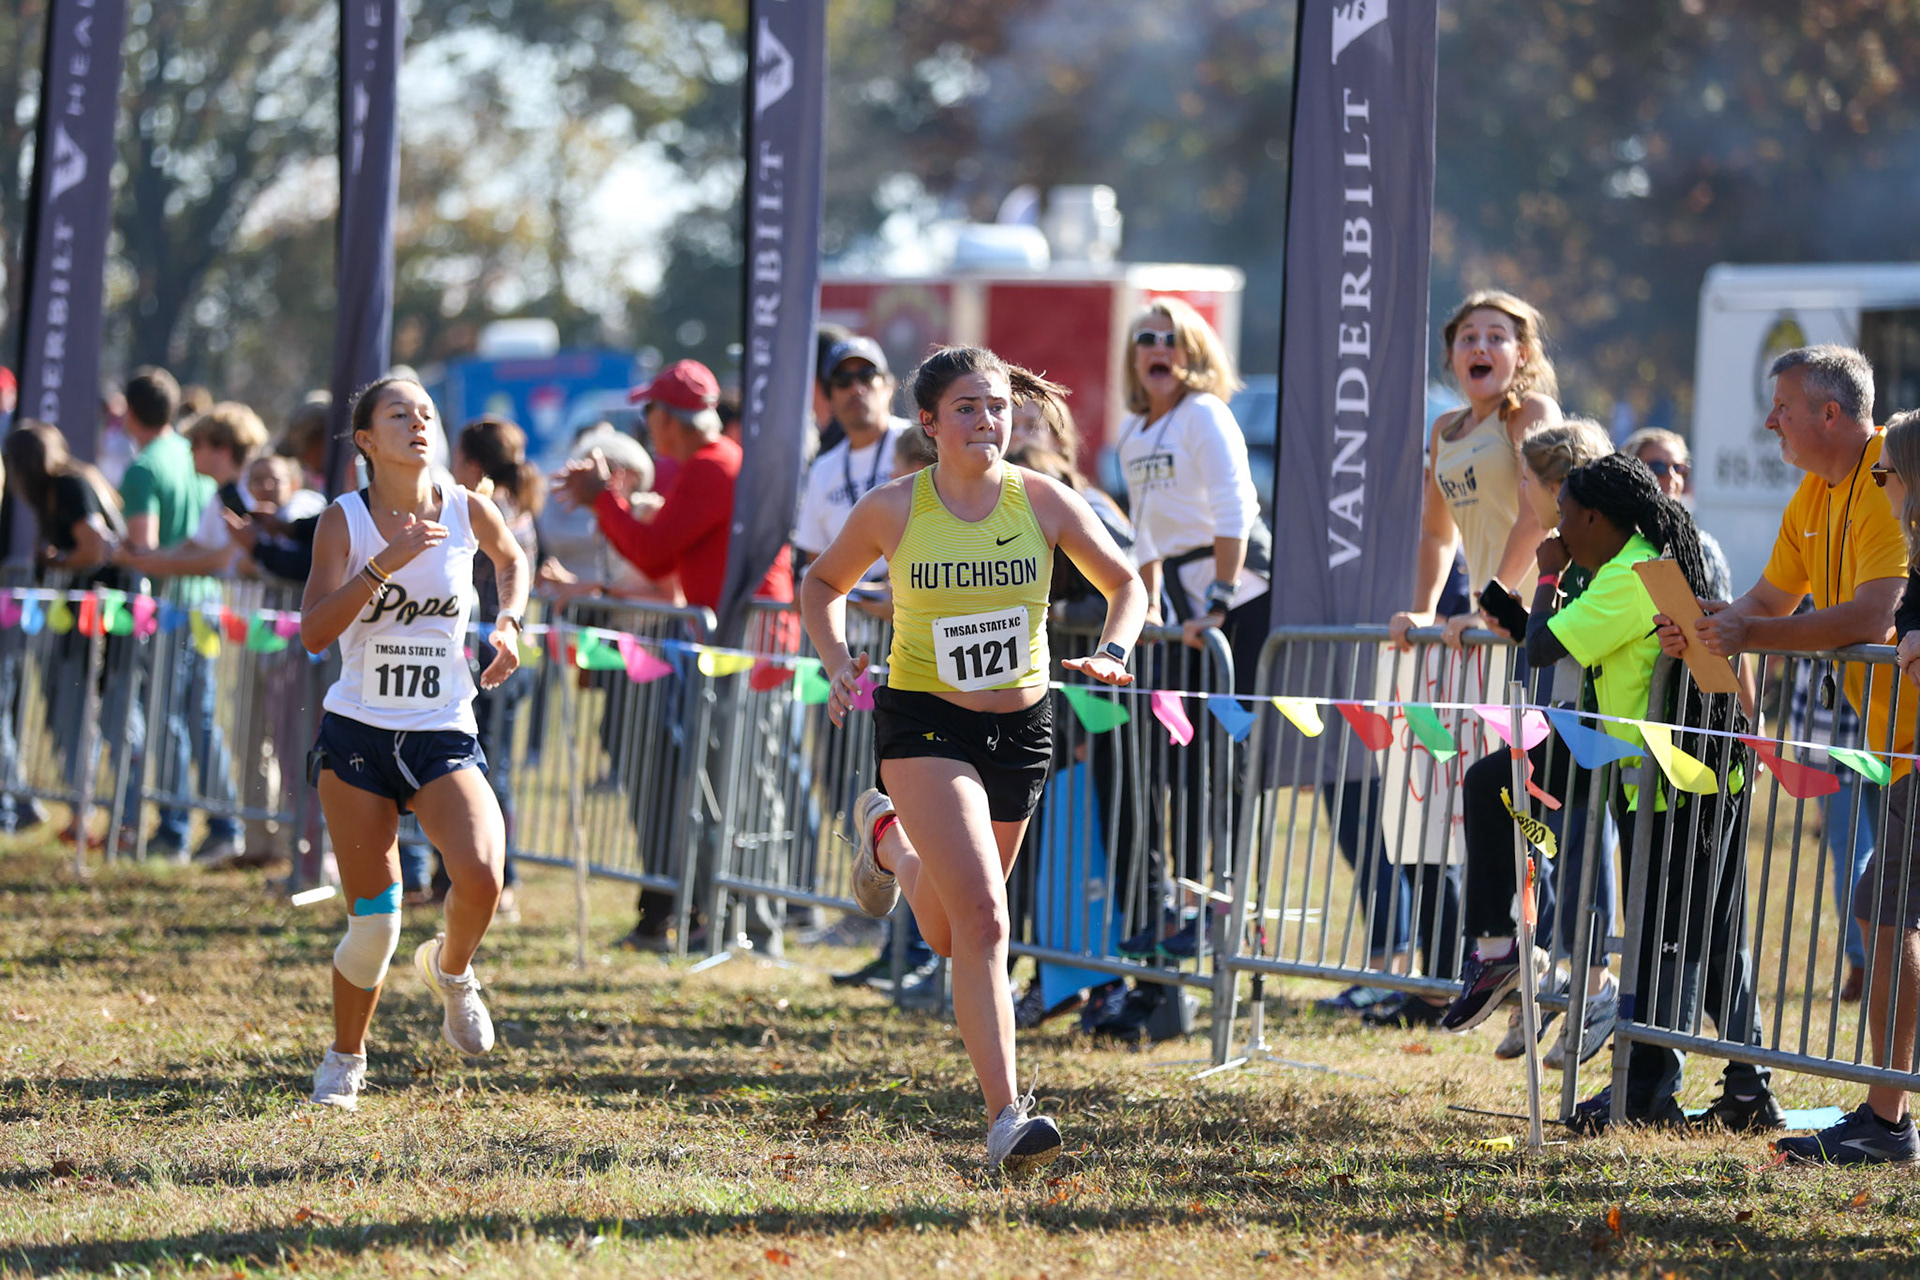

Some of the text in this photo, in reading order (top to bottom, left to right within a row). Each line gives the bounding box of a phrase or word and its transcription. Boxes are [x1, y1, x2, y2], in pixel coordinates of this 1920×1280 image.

[1327, 86, 1373, 571] VANDERBILT
[911, 557, 1037, 589] HUTCHISON
[943, 616, 1021, 638] TMSAA STATE XC
[375, 644, 447, 658] TMSAA STATE XC
[948, 635, 1019, 681] 1121
[375, 663, 441, 699] 1178
